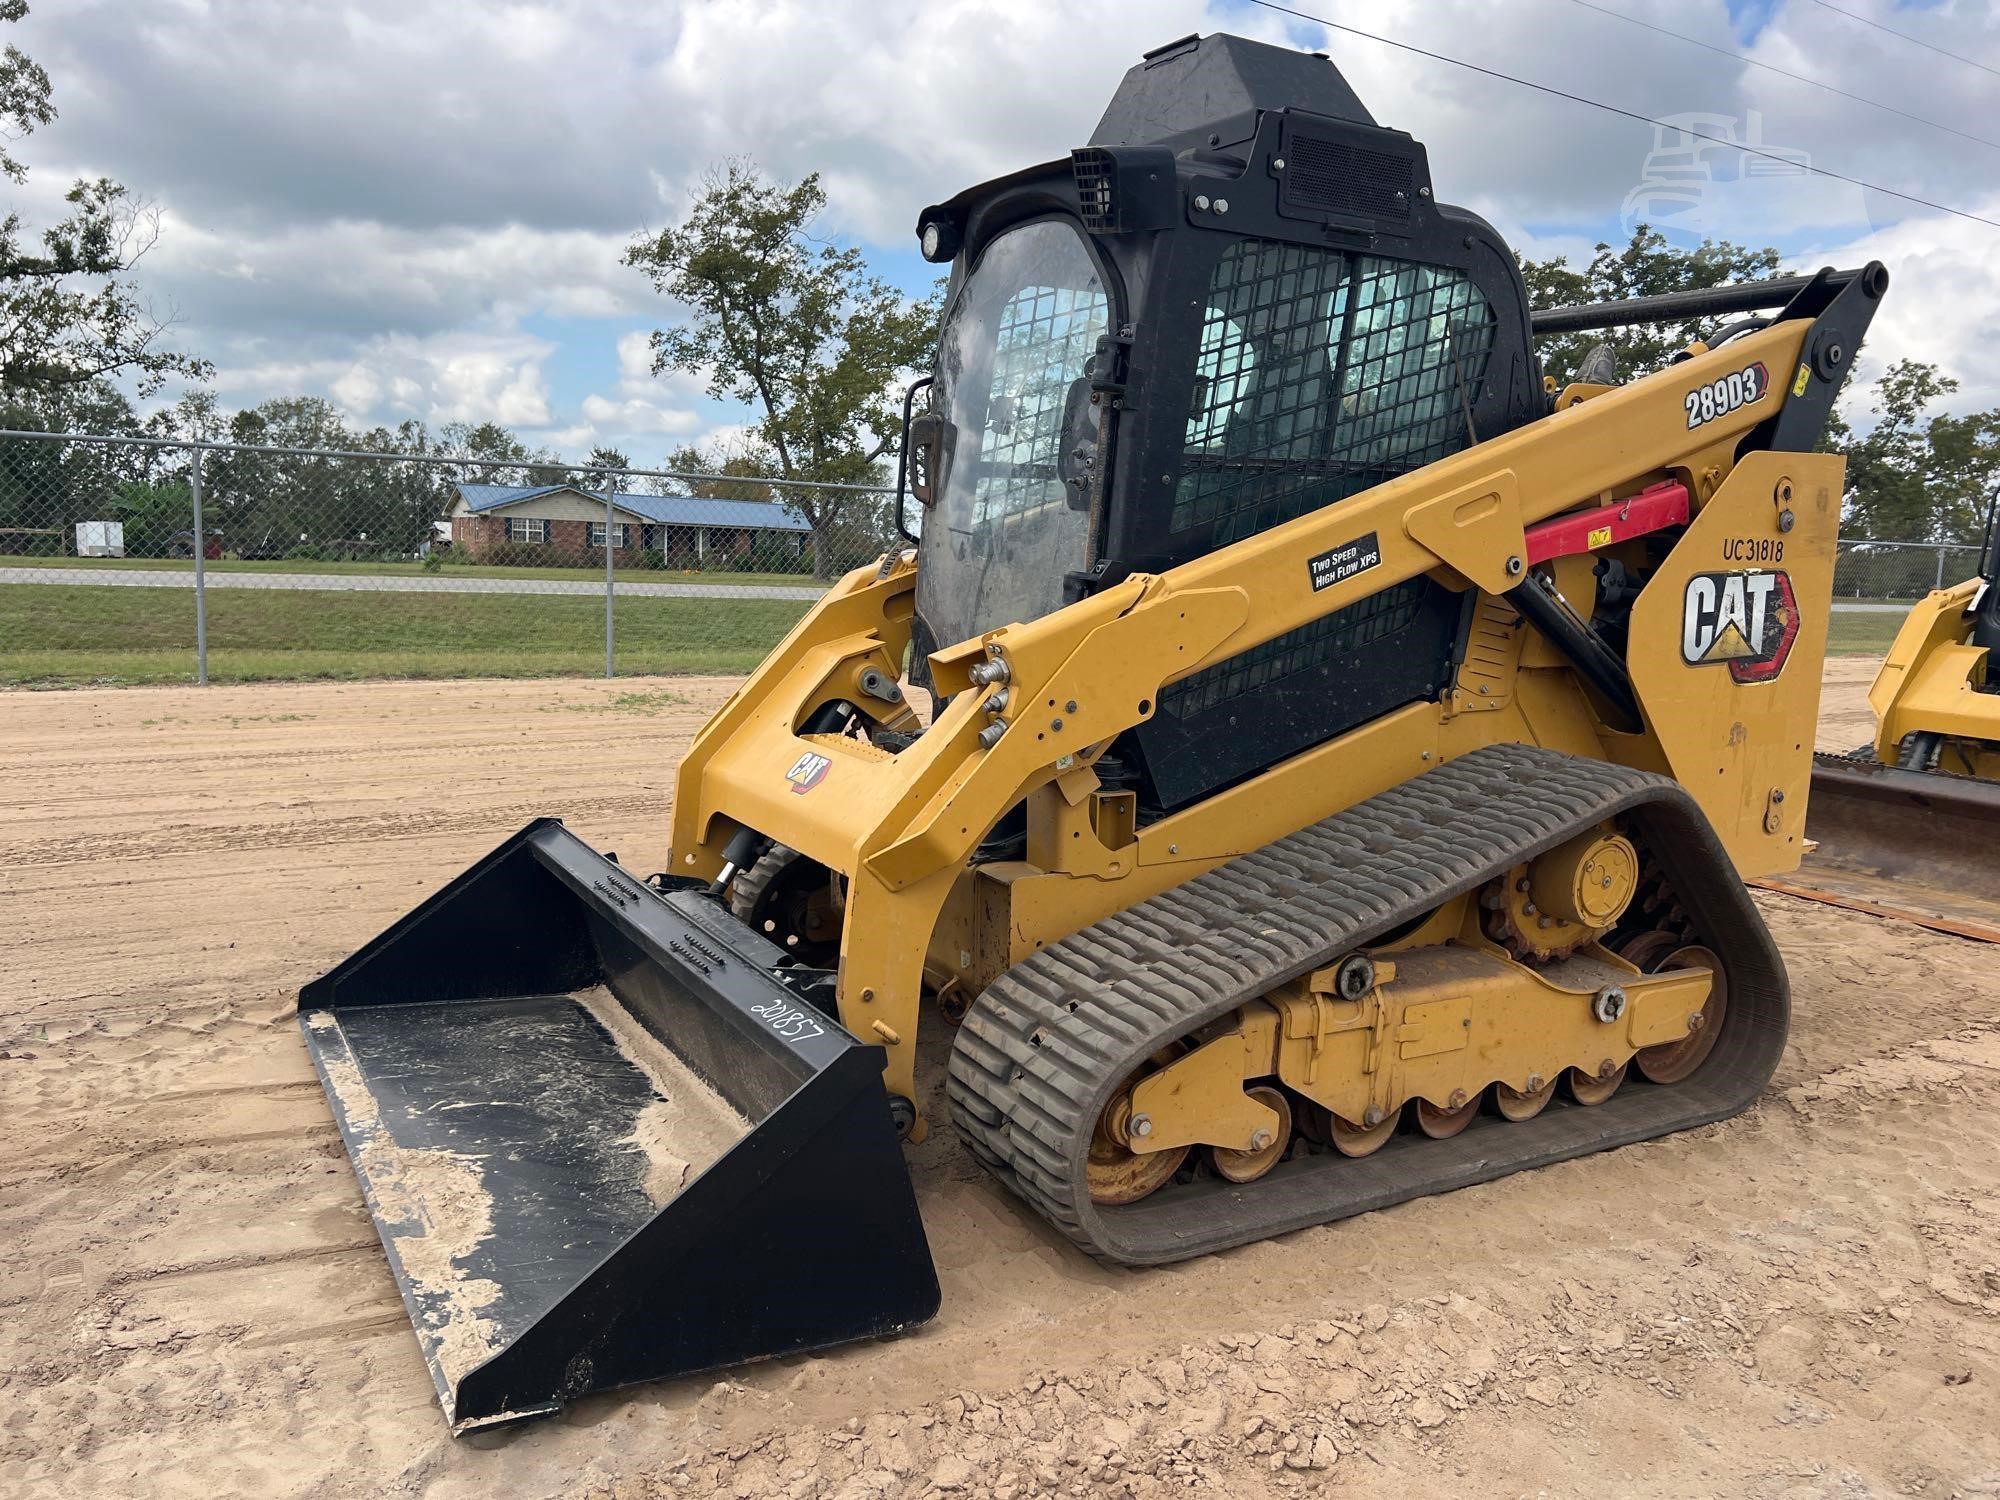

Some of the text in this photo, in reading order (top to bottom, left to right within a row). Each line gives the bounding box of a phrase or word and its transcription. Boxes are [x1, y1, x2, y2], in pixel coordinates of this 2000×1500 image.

[1685, 366, 1758, 428] 289D3
[1360, 551, 1377, 568] XPS
[1683, 574, 1776, 662] CAT
[786, 751, 831, 786] CAT
[750, 998, 825, 1043] 201857
